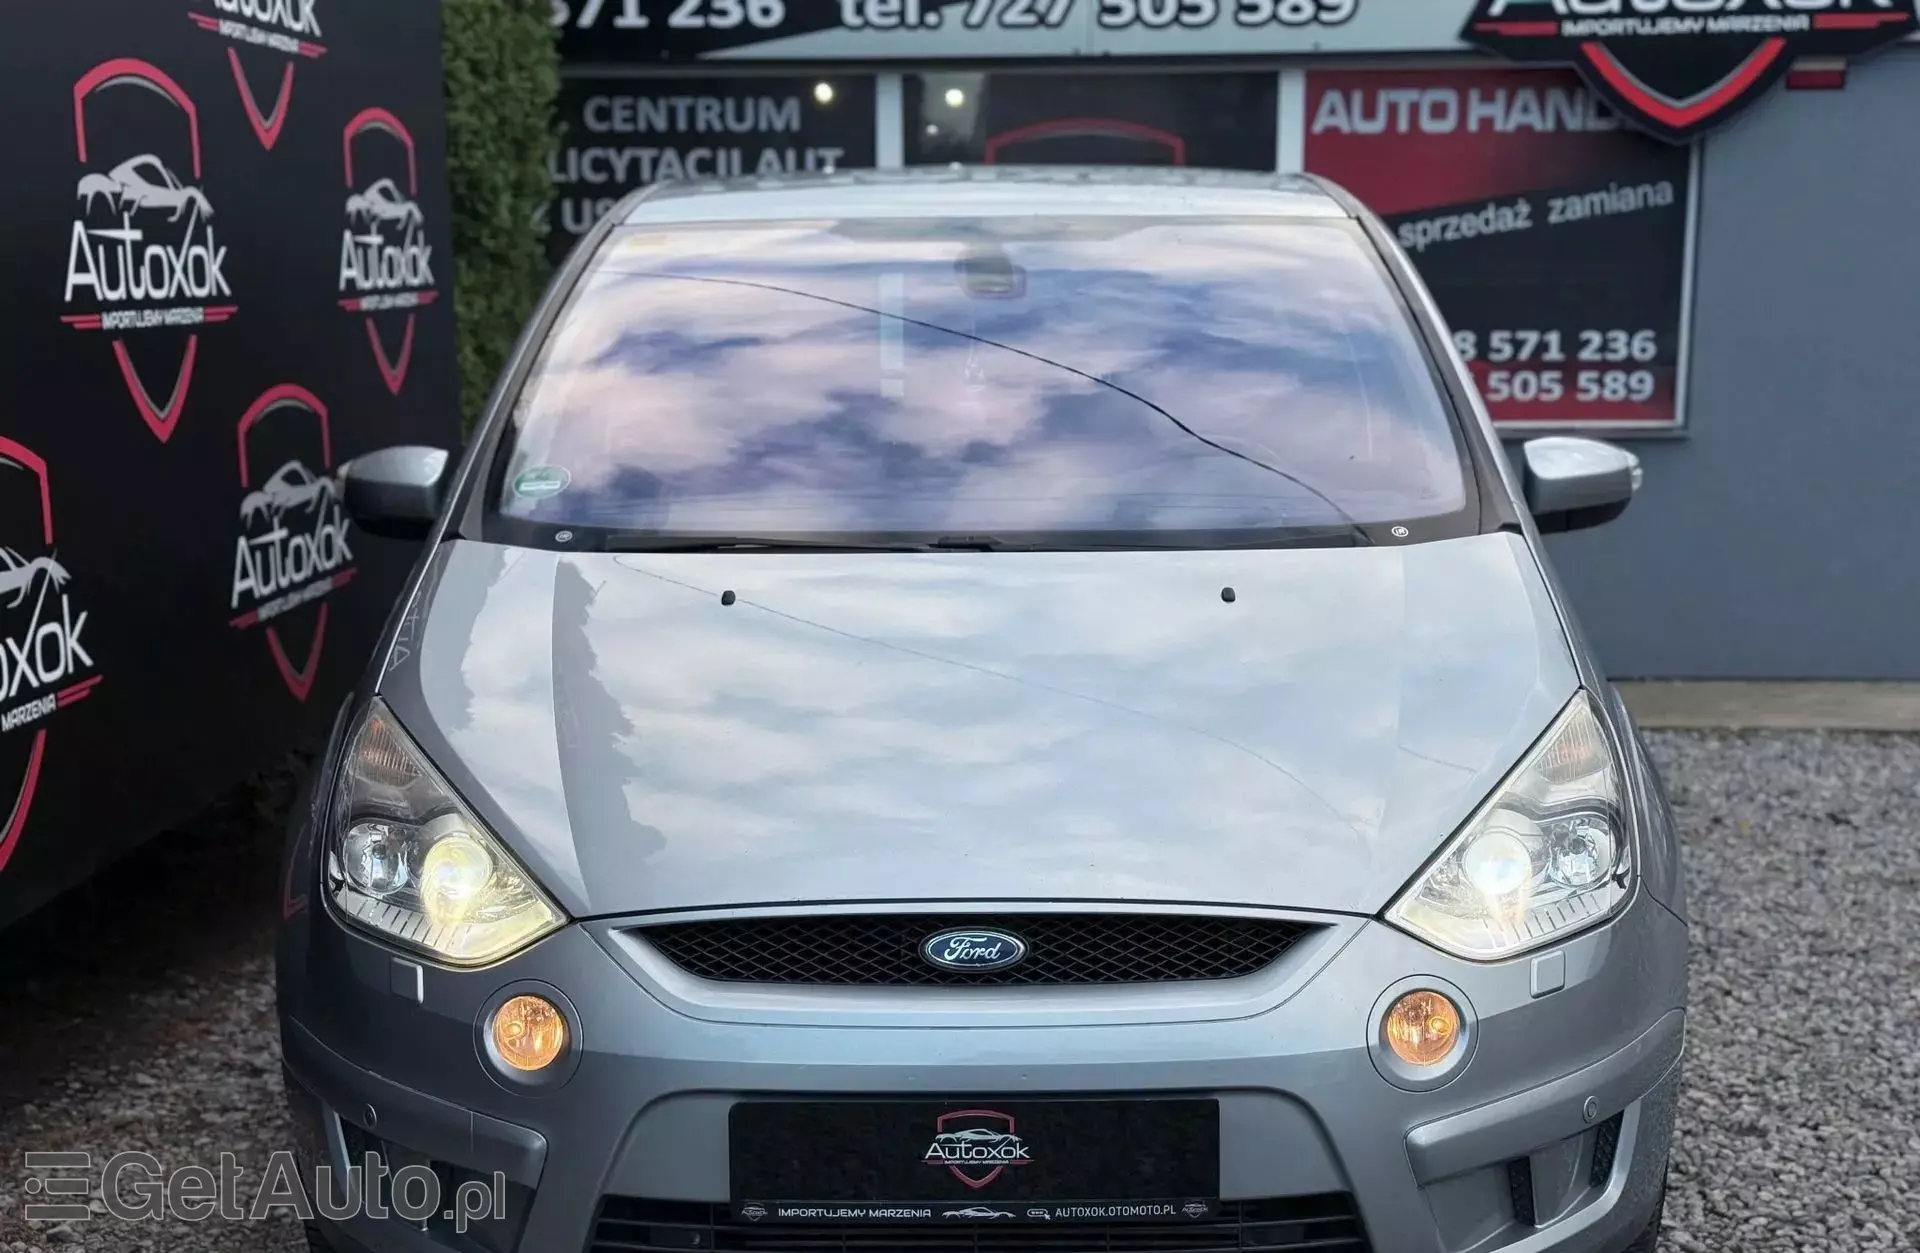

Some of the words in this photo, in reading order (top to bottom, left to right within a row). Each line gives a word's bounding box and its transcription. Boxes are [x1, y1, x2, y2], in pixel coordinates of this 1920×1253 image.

[667, 0, 786, 28] 236
[841, 0, 940, 27] tel.
[1562, 17, 1704, 36] IMPORTUJEMY
[1706, 14, 1810, 33] MARZENIA
[583, 95, 802, 133] CENTRUM
[1312, 88, 1457, 134] AUTO
[1398, 197, 1533, 251] sprzedaż
[1547, 179, 1675, 225] zamiana
[64, 211, 232, 302] Autoxok
[339, 222, 435, 291] Autoxok
[1488, 329, 1566, 362] 571
[1577, 329, 1657, 362] 236
[1486, 370, 1565, 402] 505
[1576, 370, 1655, 402] 589
[231, 504, 354, 609] Autoxok
[0, 588, 94, 701] xok
[1, 692, 57, 732] MARZENIA
[943, 936, 1002, 961] Ford
[924, 1140, 1031, 1160] Autoxok
[777, 1207, 866, 1218] IMPORTUJEMY
[868, 1207, 932, 1218] MARZENIA
[1054, 1204, 1177, 1218] AUTOXOK.OTOMOTO.PL
